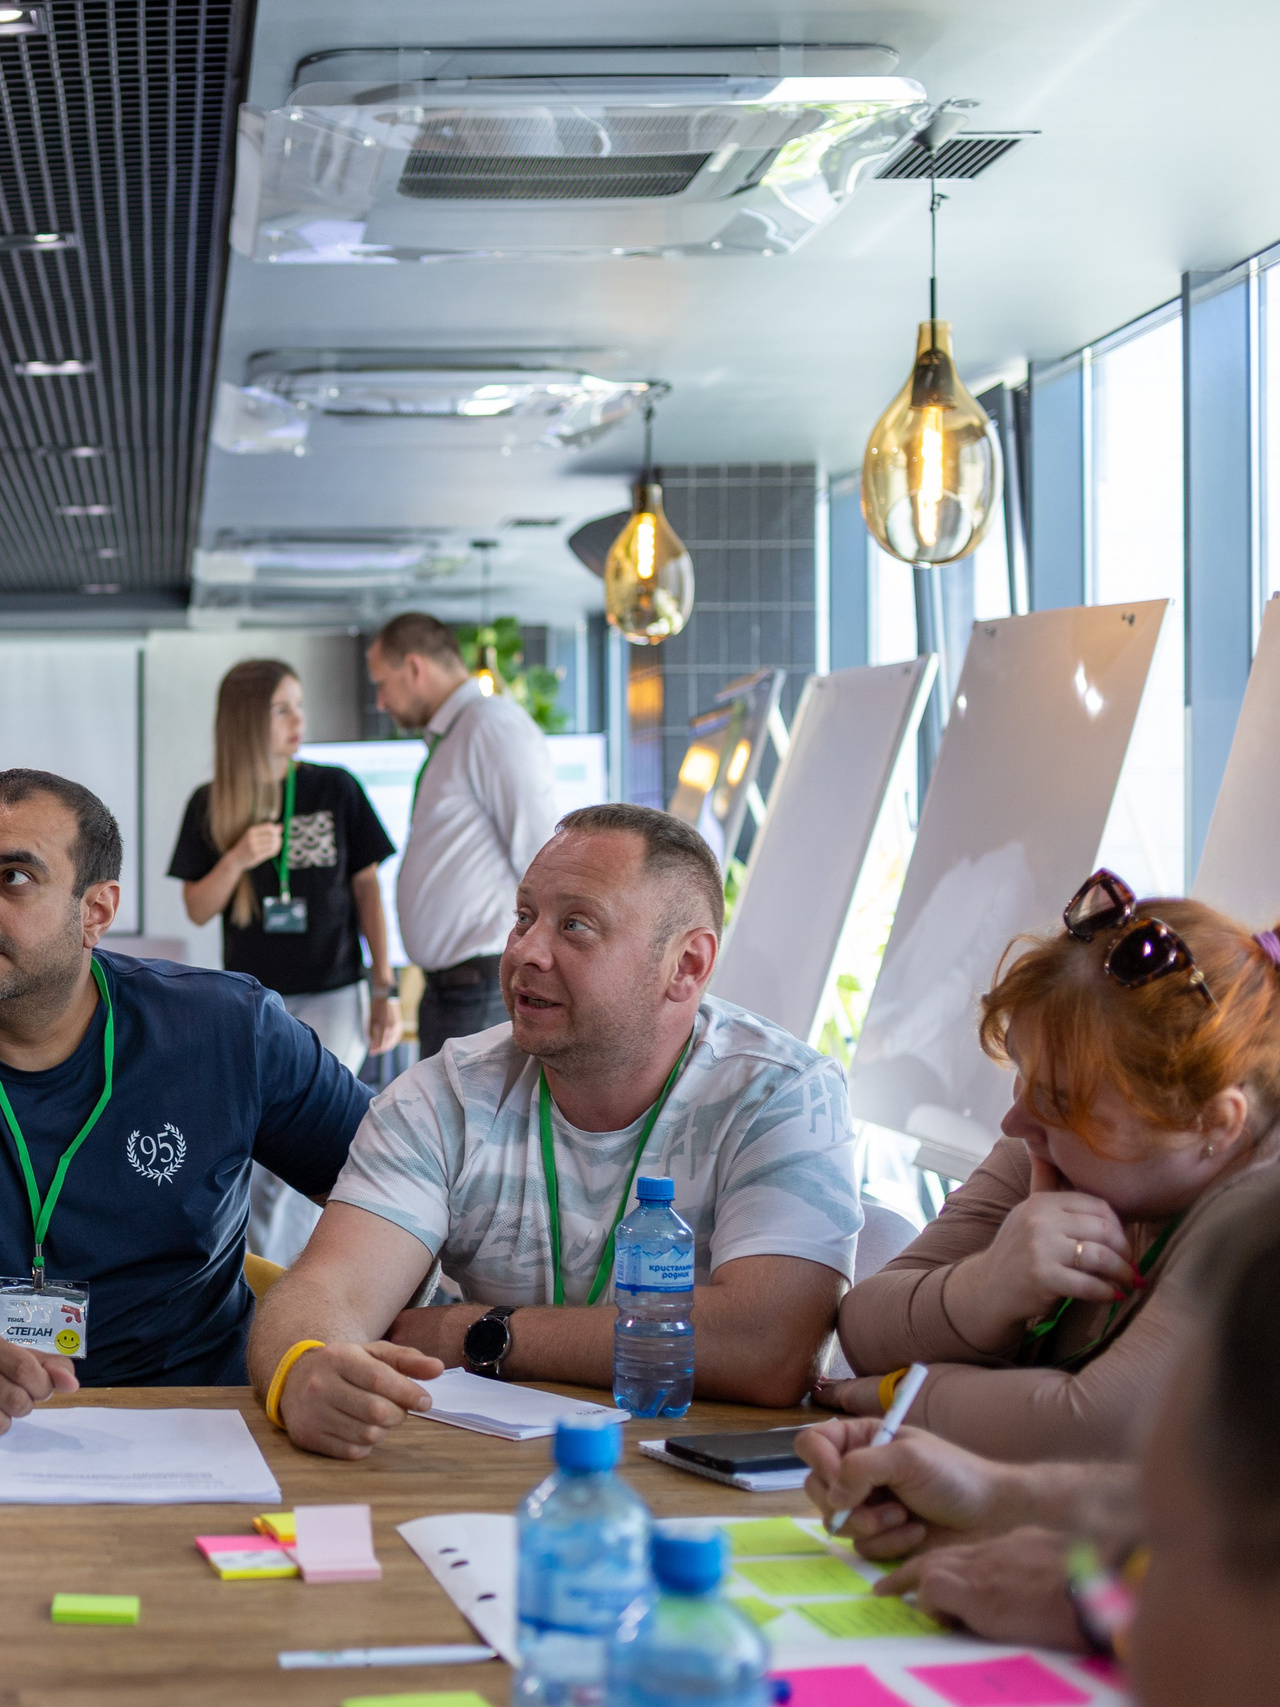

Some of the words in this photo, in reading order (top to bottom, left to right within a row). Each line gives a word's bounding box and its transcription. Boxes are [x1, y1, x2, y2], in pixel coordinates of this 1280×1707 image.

[140, 1131, 174, 1167] 95
[662, 1272, 690, 1280] родник
[6, 1326, 53, 1337] СТЕПАН
